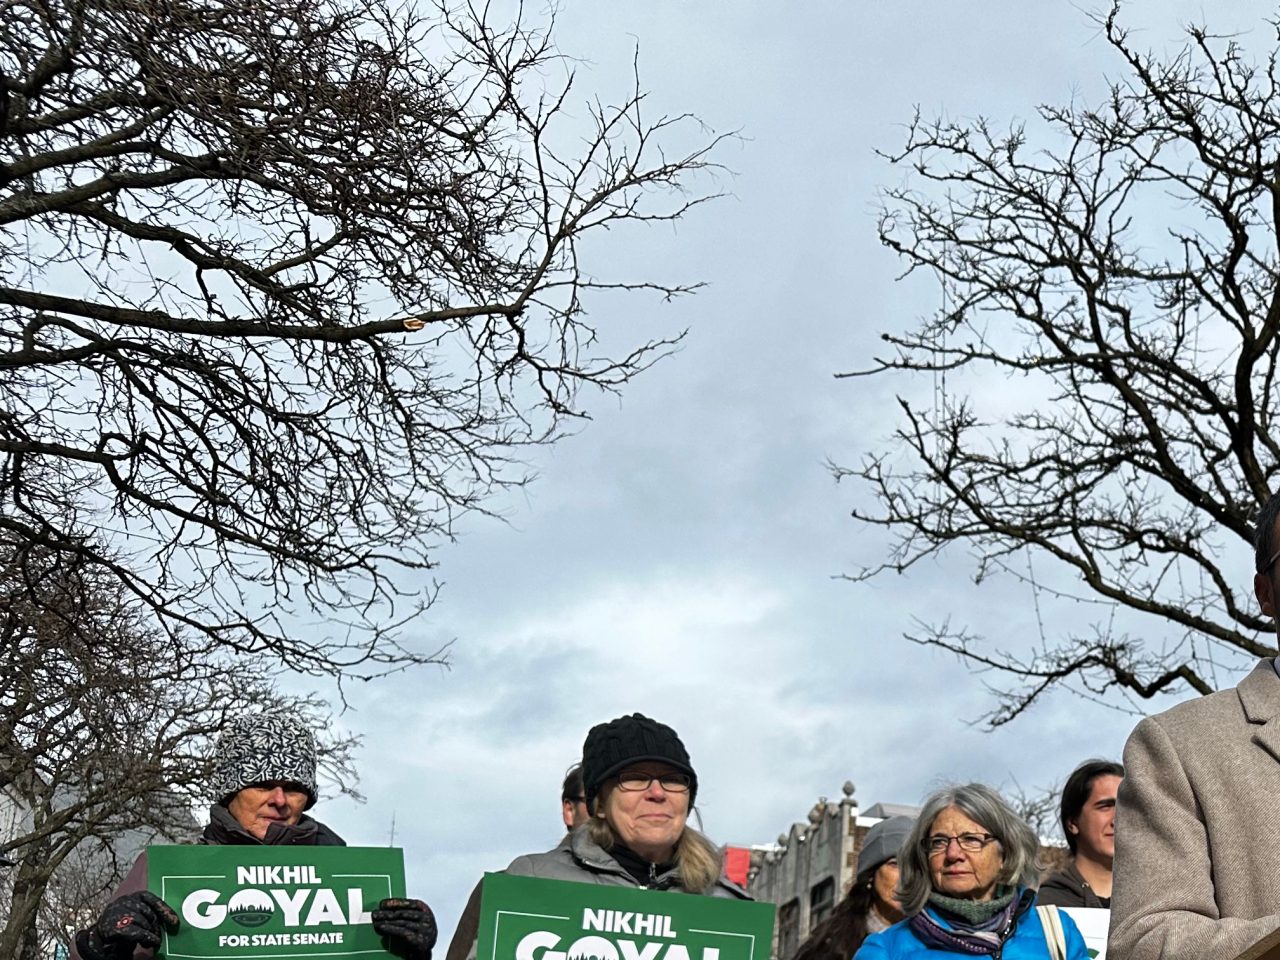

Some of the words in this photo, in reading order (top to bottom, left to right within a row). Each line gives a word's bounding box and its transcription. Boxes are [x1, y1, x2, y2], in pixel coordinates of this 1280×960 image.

[236, 865, 322, 885] NIKHIL
[181, 888, 372, 929] GOYAL
[582, 908, 677, 939] NIKHIL
[218, 934, 250, 947] FOR
[251, 933, 291, 947] STATE
[292, 932, 344, 945] SENATE
